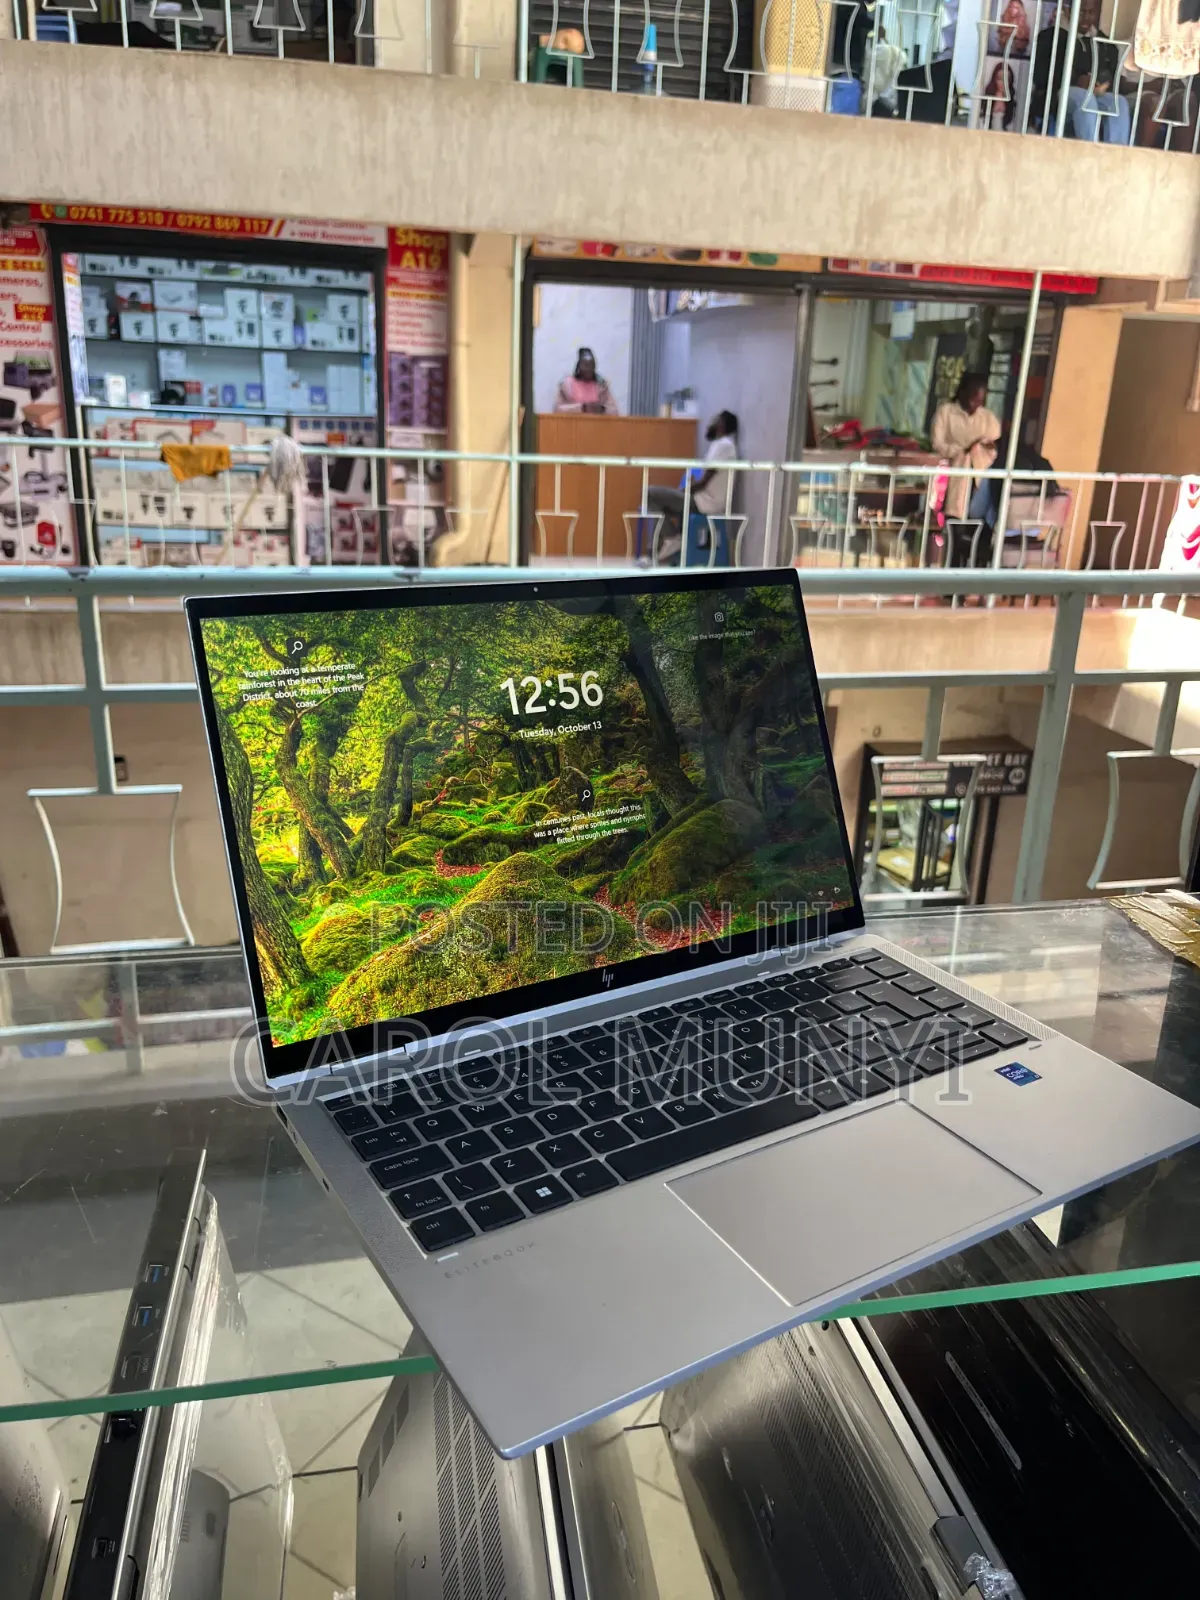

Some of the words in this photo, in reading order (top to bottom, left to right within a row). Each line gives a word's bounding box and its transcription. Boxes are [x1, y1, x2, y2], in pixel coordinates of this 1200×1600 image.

[395, 227, 448, 250] Shop
[238, 680, 277, 690] rainforest
[278, 678, 286, 687] in
[287, 677, 300, 686] the
[301, 675, 321, 685] heart
[323, 674, 332, 683] of
[333, 673, 346, 682] the
[346, 672, 365, 681] Peak
[244, 669, 269, 679] You're
[270, 666, 300, 676] looking
[301, 666, 309, 674] at
[317, 662, 356, 674] temperate
[274, 689, 298, 699] about
[299, 688, 310, 696] 70
[310, 686, 331, 695] miles
[332, 684, 351, 693] from
[351, 683, 365, 691] the
[499, 670, 604, 716] 12:56
[519, 727, 556, 739] Tuesday,
[557, 723, 592, 735] October
[592, 720, 603, 730] 13
[533, 830, 547, 838] was
[552, 827, 569, 837] place
[569, 823, 589, 832] where
[610, 817, 622, 825] and
[622, 813, 647, 824] nymphs
[543, 815, 572, 826] centuries
[587, 810, 605, 819] locals
[605, 806, 630, 816] thought
[630, 804, 642, 812] this
[575, 831, 601, 842] through
[364, 1136, 379, 1145] tab
[471, 1104, 485, 1113] W
[383, 1162, 403, 1172] caps
[402, 1156, 420, 1165] lock
[546, 1112, 558, 1121] D
[425, 1195, 443, 1205] lock
[503, 1159, 516, 1168] Z
[549, 1144, 562, 1153] X
[425, 1221, 441, 1231] ctrl
